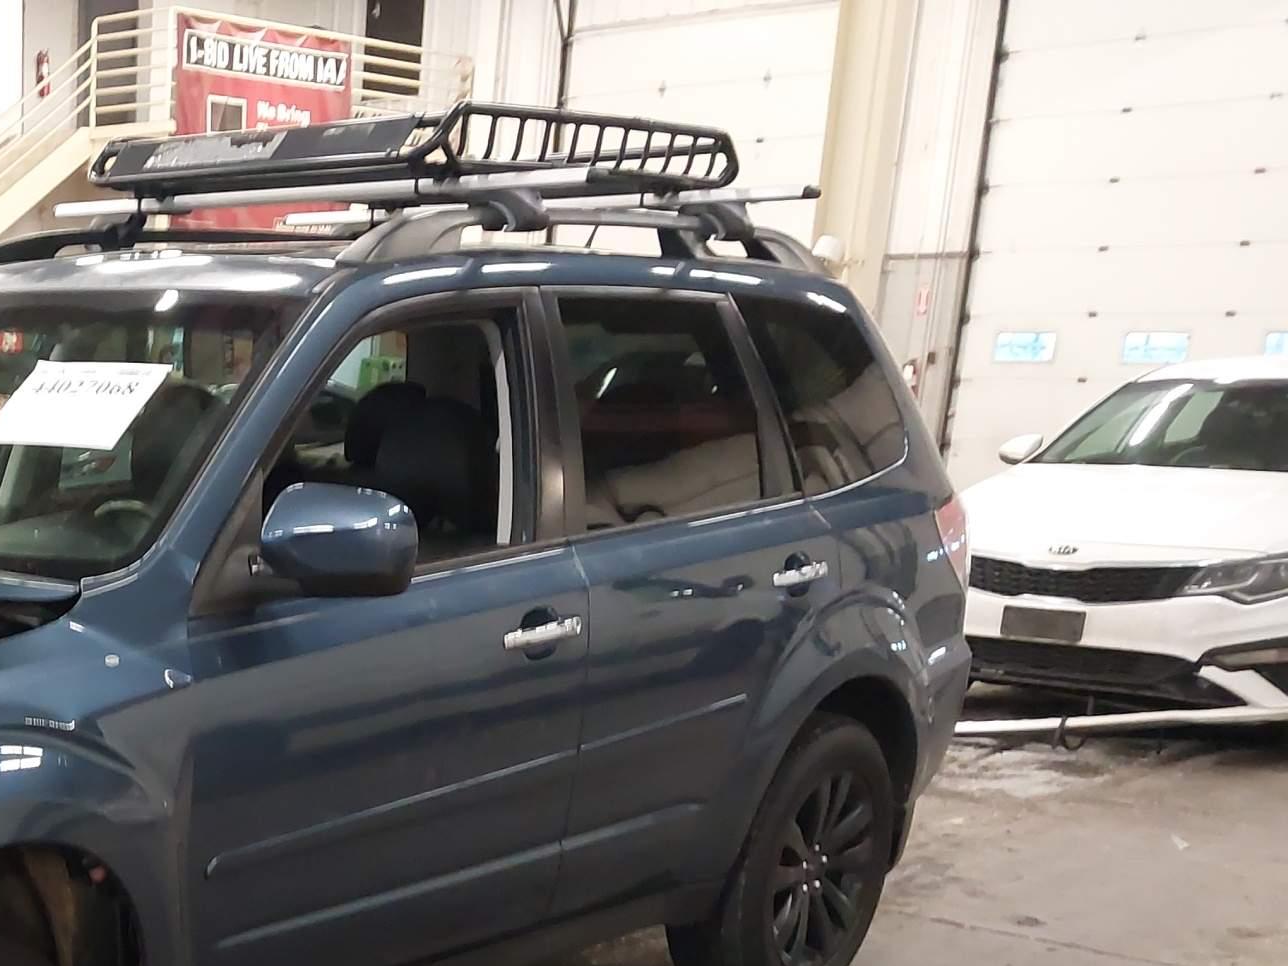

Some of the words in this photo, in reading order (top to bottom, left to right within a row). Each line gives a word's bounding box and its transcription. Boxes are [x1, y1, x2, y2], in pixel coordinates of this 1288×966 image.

[232, 43, 268, 75] LIVE
[269, 49, 314, 81] FROM
[277, 103, 311, 128] Bring
